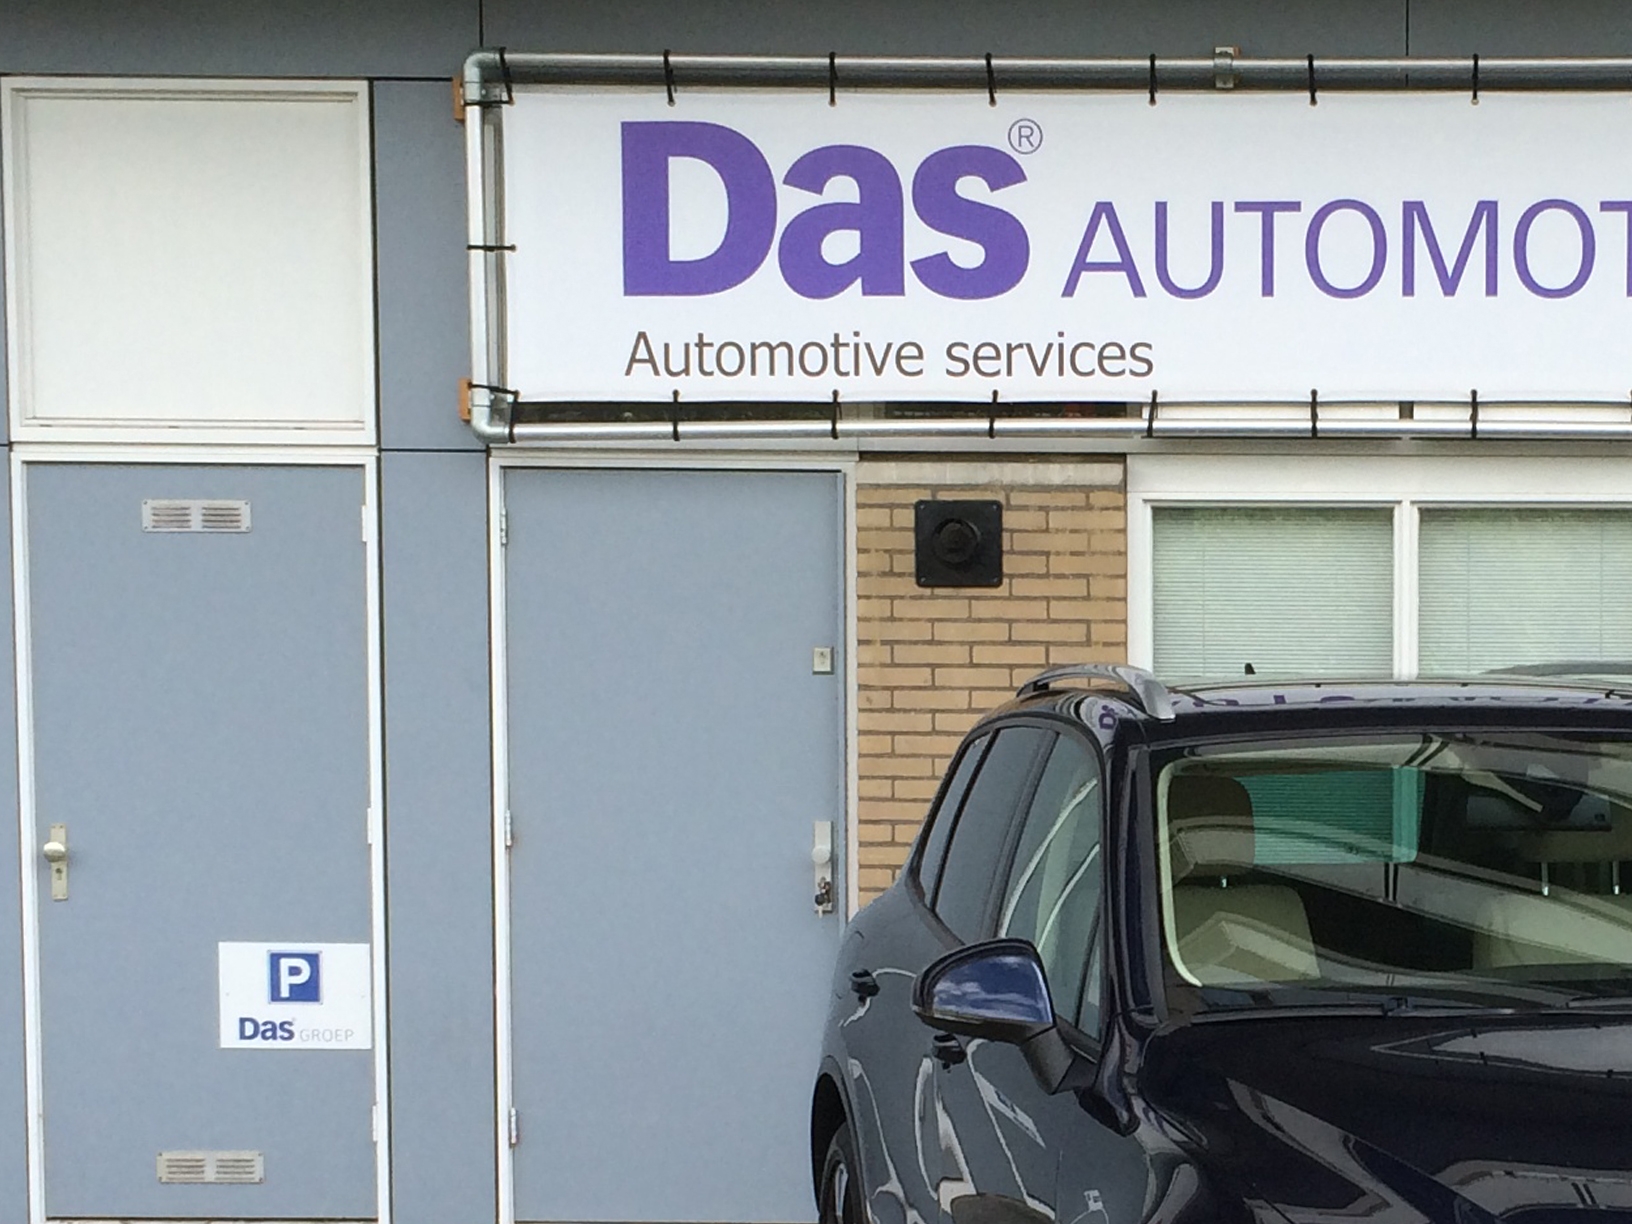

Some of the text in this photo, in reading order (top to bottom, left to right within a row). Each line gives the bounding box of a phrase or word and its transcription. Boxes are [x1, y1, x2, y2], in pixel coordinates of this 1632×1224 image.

[624, 330, 1154, 378] Automotive services
[279, 957, 311, 998] P
[238, 1017, 354, 1042] Das GROEP
